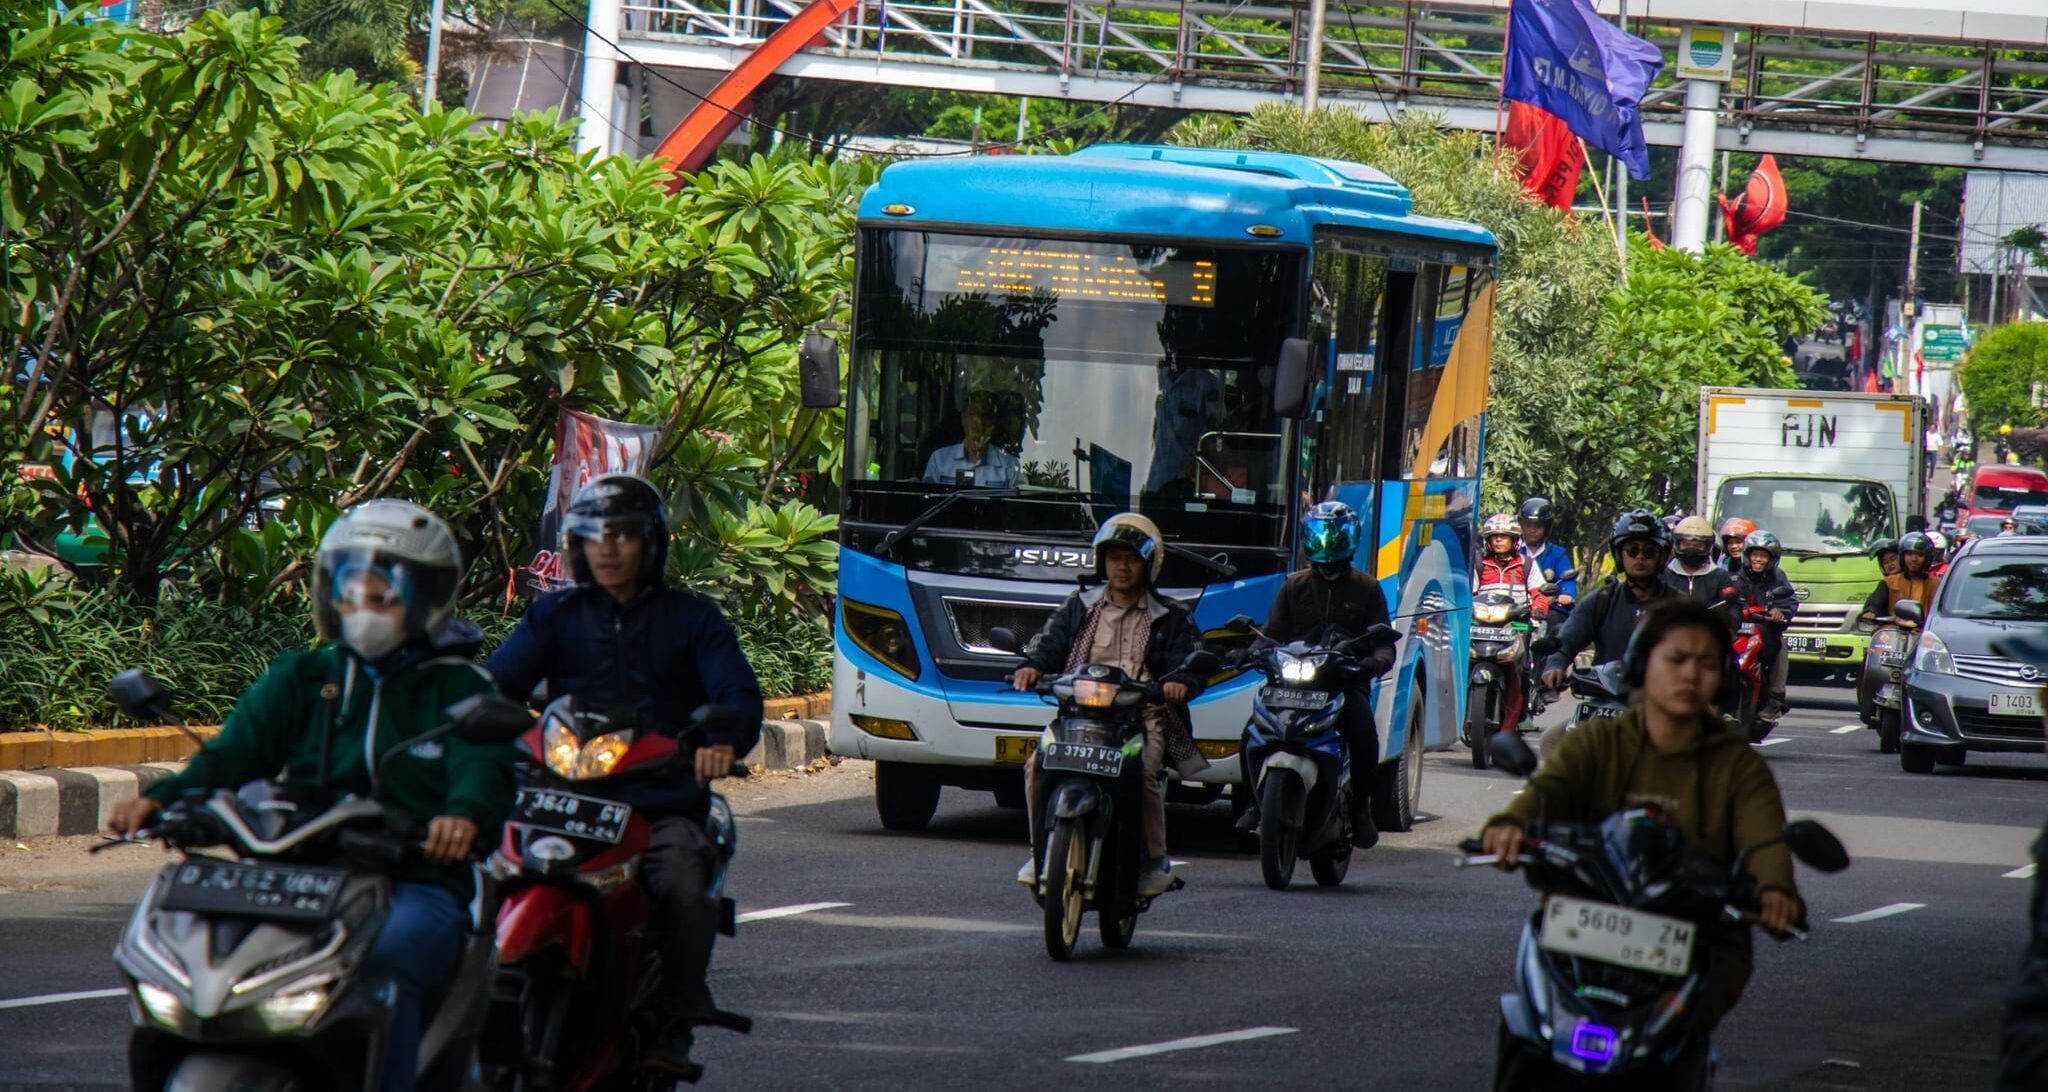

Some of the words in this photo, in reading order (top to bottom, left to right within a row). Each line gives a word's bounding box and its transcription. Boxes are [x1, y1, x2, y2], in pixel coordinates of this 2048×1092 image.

[1013, 548, 1097, 568] ISUZU
[1787, 637, 1808, 647] 8910
[1815, 639, 1826, 648] DH
[1991, 694, 1998, 707] D
[2006, 695, 2033, 709] 1403
[1582, 705, 1589, 714] D
[998, 739, 1007, 754] D
[1048, 745, 1057, 756] D
[1065, 746, 1094, 759] 3797
[1099, 748, 1121, 762] VCP
[1551, 902, 1562, 919] F
[1578, 906, 1633, 936] 5609
[1657, 924, 1690, 945] ZM
